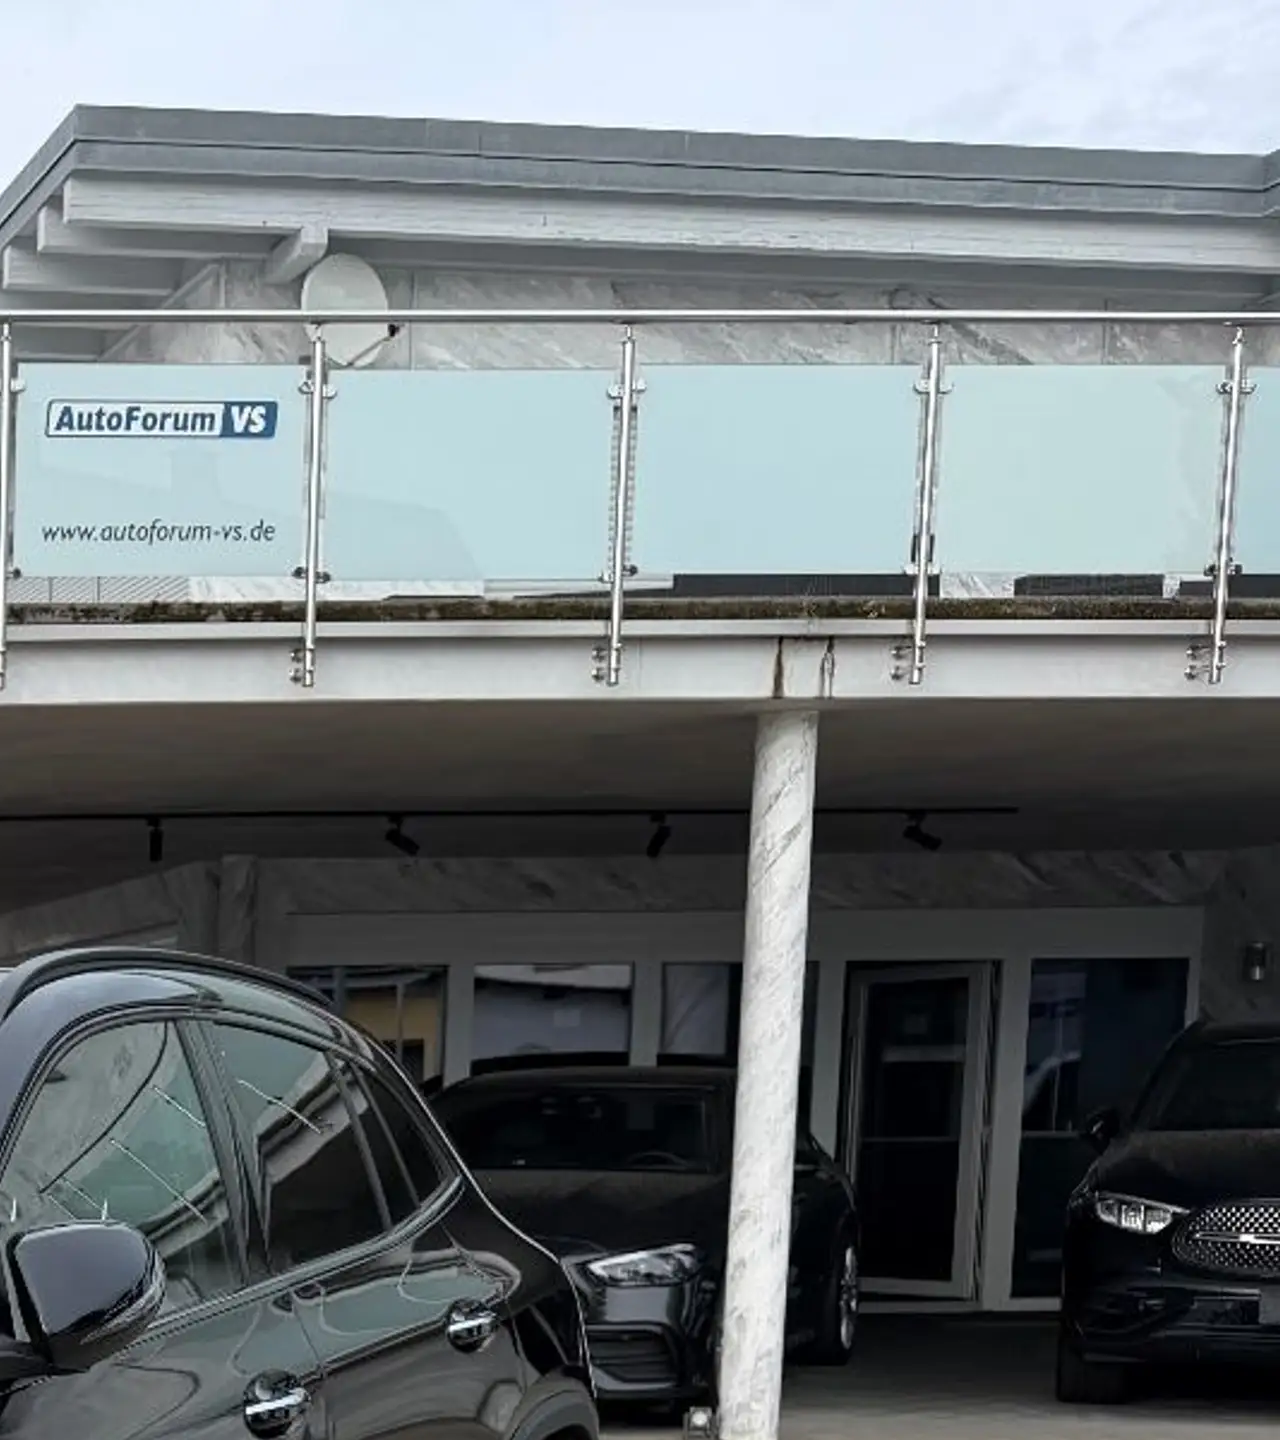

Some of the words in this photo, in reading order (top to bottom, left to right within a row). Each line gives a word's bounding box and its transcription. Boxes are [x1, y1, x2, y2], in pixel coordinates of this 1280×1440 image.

[54, 405, 216, 431] AutoForum
[230, 404, 267, 433] VS
[41, 518, 277, 546] www.autoforum-vs.de
